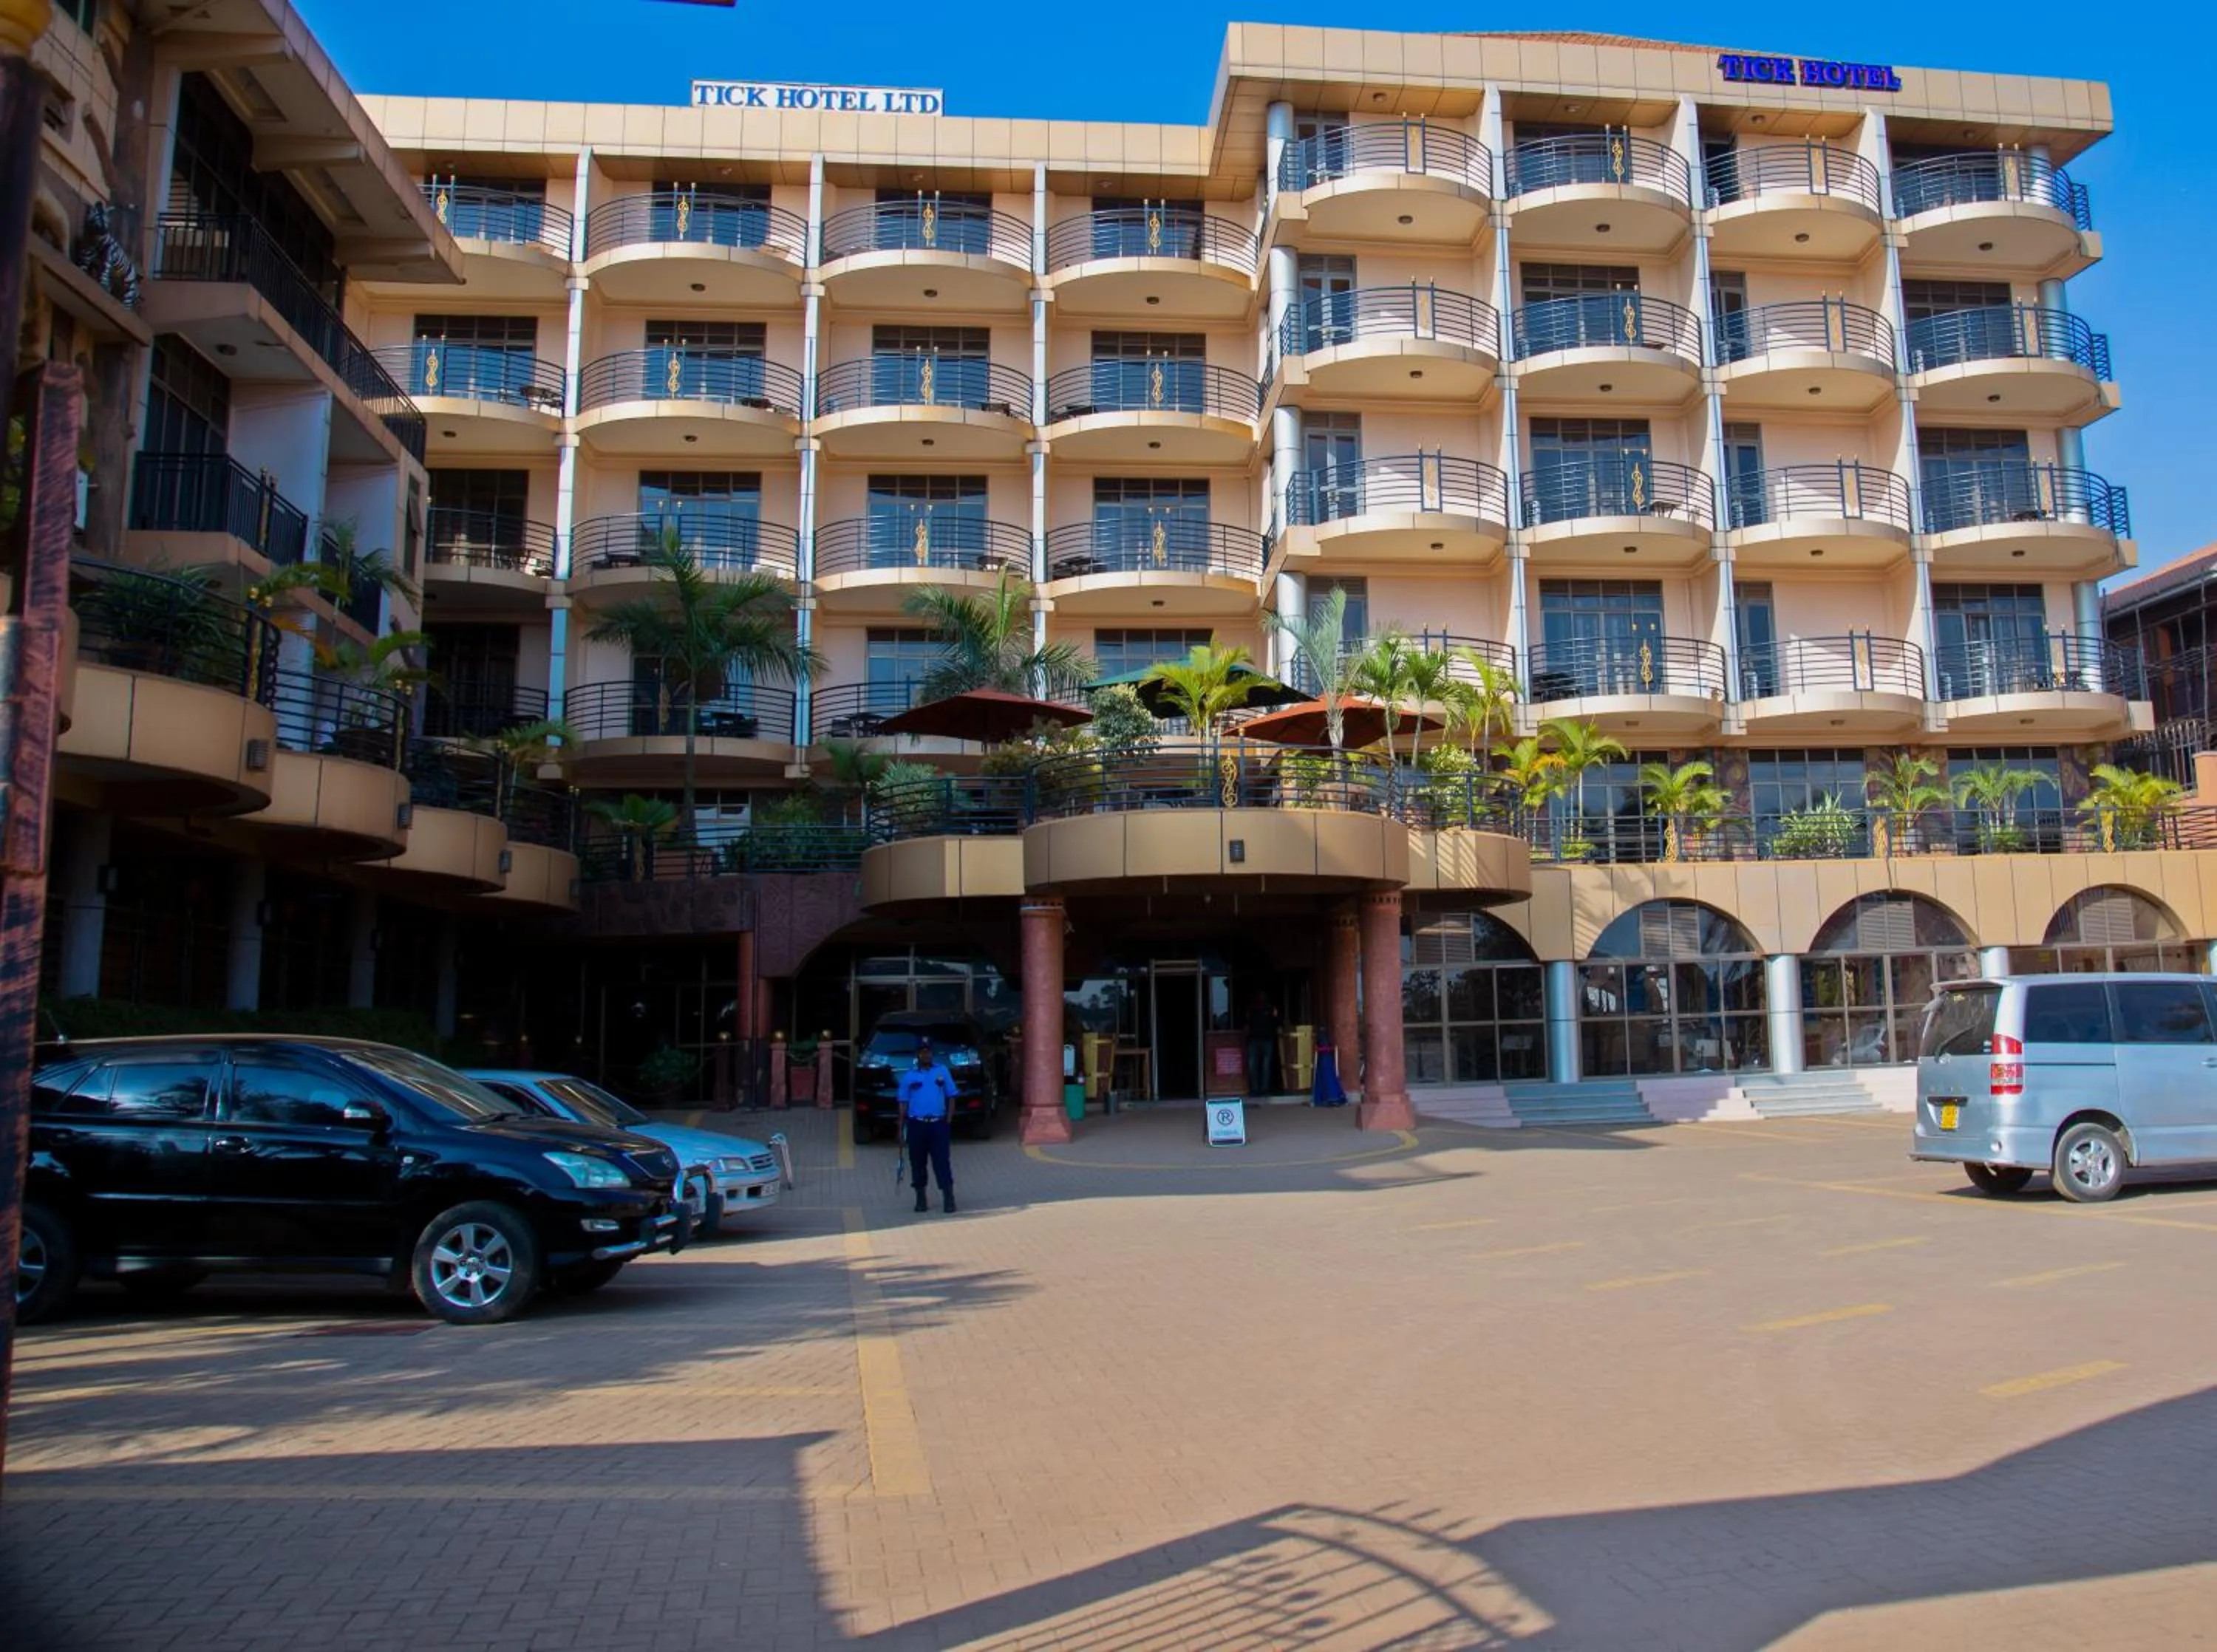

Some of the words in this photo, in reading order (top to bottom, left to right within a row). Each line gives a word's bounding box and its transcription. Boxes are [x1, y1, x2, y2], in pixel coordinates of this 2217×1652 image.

[1717, 55, 1796, 85] TICK
[1799, 60, 1902, 92] HOTEL
[695, 84, 767, 107] TICK
[775, 87, 876, 112] HOTEL
[884, 92, 939, 114] LTD
